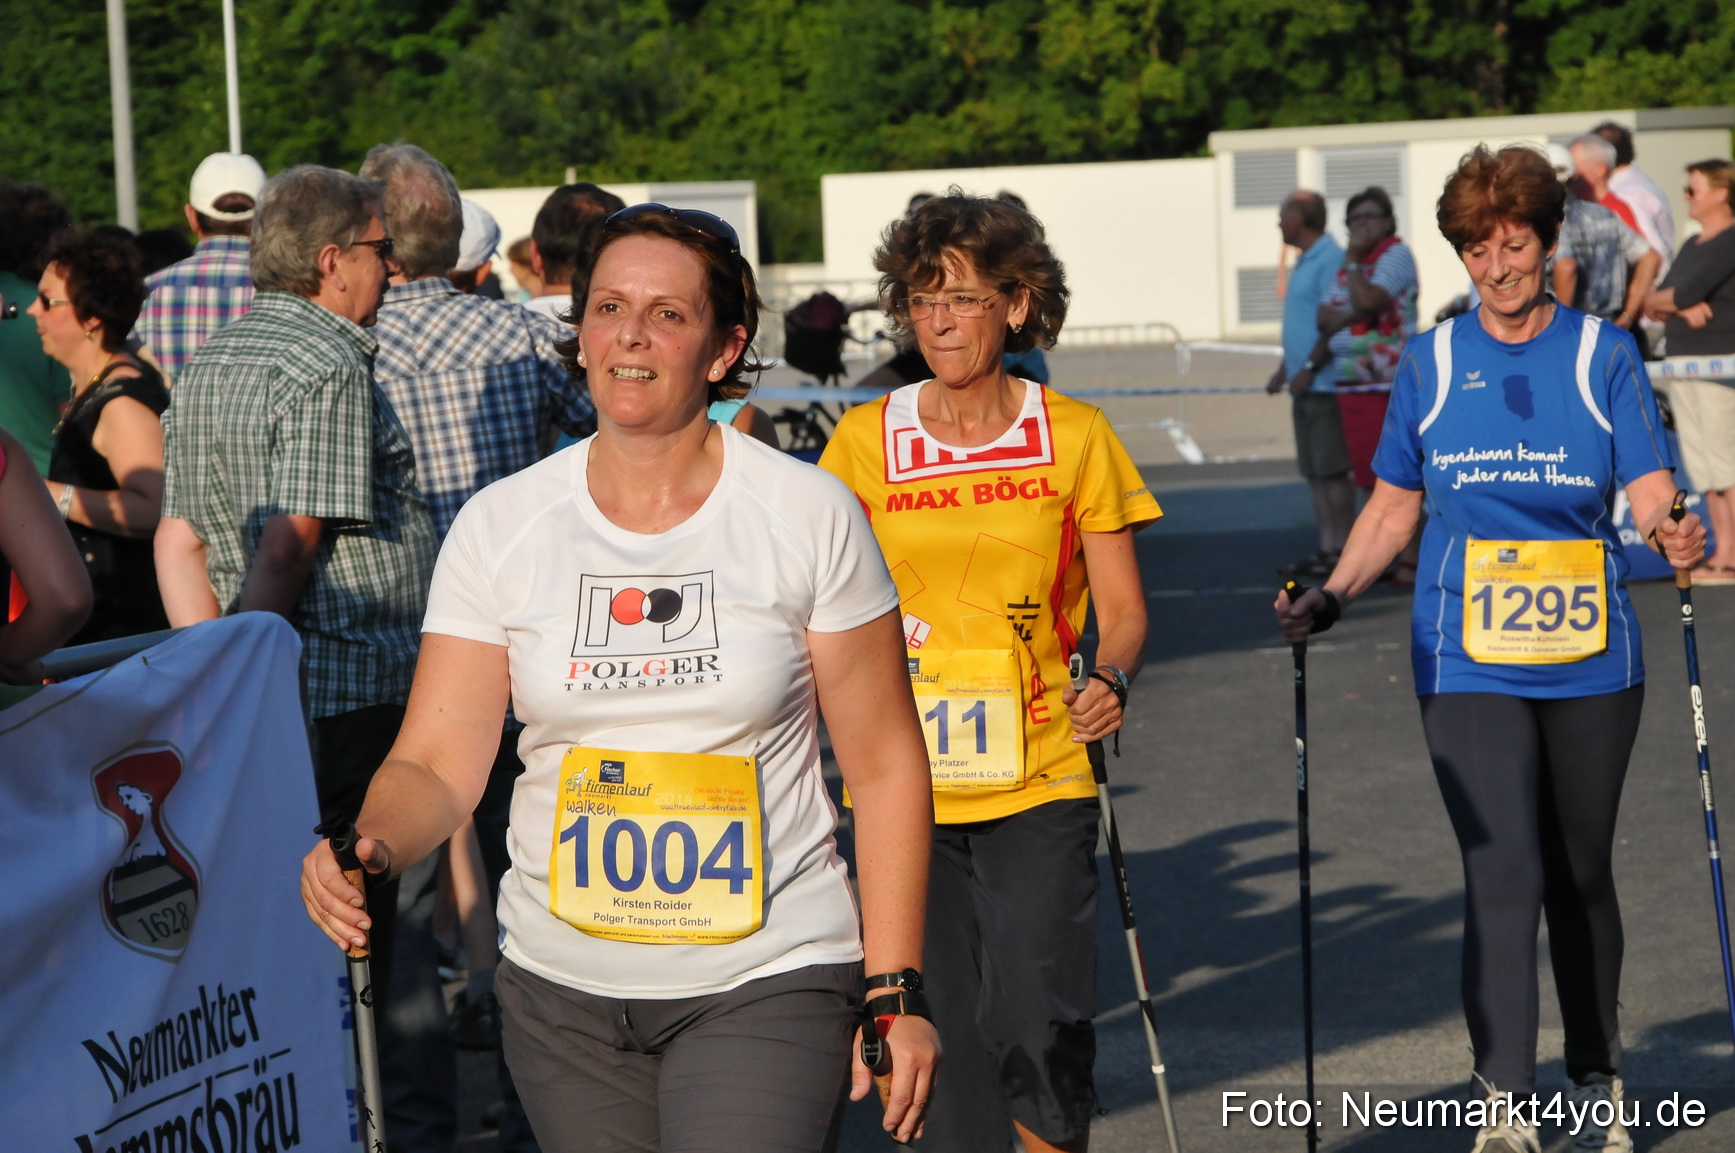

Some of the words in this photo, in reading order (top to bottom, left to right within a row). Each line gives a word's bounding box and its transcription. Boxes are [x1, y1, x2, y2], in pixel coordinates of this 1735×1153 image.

[1432, 447, 1513, 470] Irgendwann
[1452, 468, 1498, 490] jeder
[1502, 468, 1539, 483] nach
[1544, 465, 1596, 487] Hause.
[886, 487, 962, 513] MAX
[973, 475, 1059, 505] BÖGL
[1472, 585, 1600, 632] 1295
[565, 654, 722, 680] POLGER
[910, 672, 940, 682] enlauf
[565, 674, 723, 692] TRANSPORT
[925, 700, 987, 755] 11
[586, 779, 653, 797] firmenlauf
[566, 799, 616, 816] walken
[560, 815, 753, 895] 1004
[613, 897, 651, 910] Kirsten
[654, 900, 692, 911] Roider
[137, 900, 190, 943] 1628
[594, 912, 624, 924] Polger
[628, 915, 676, 928] Transport
[680, 917, 712, 927] GmbH
[81, 981, 260, 1104] Neumarkter
